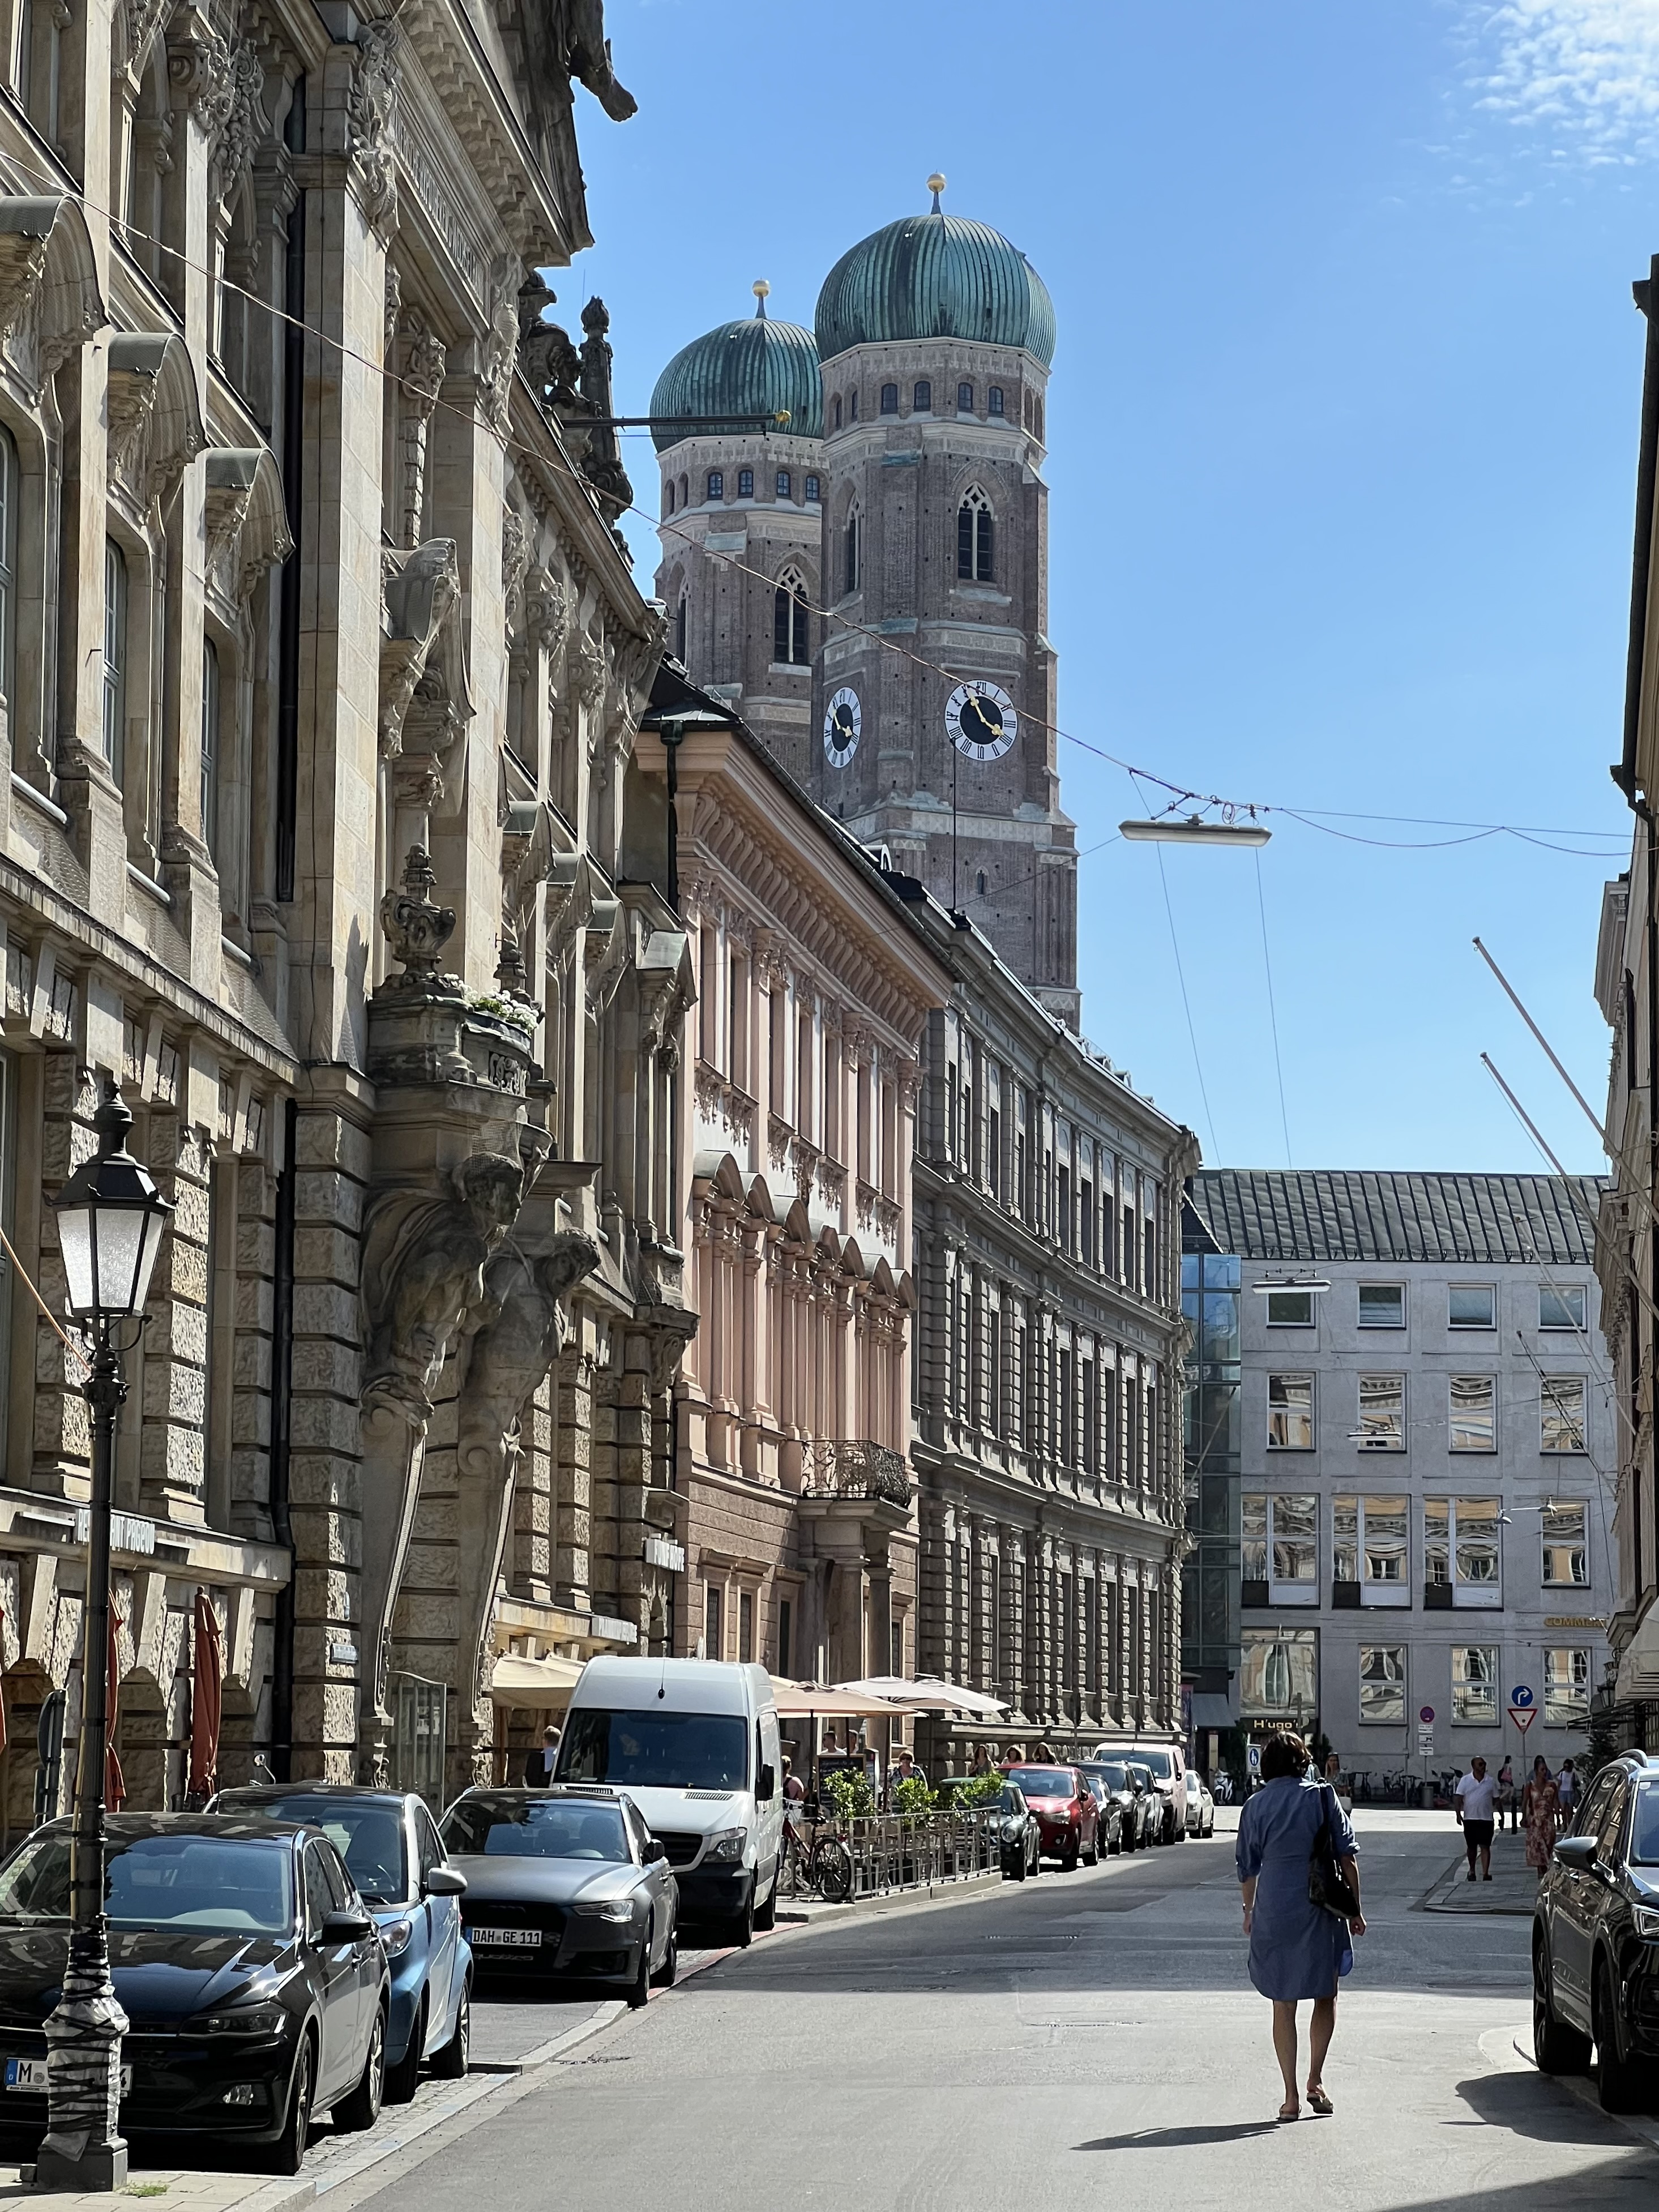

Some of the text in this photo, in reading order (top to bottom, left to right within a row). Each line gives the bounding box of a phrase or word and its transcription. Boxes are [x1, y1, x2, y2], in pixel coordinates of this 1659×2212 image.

[1003, 720, 1016, 729] III
[78, 1508, 125, 1548] REANT
[1254, 1719, 1299, 1731] H'ugo'
[473, 1929, 495, 1943] DAH
[503, 1931, 516, 1944] GE
[519, 1932, 540, 1945] 111
[18, 2063, 32, 2083] M
